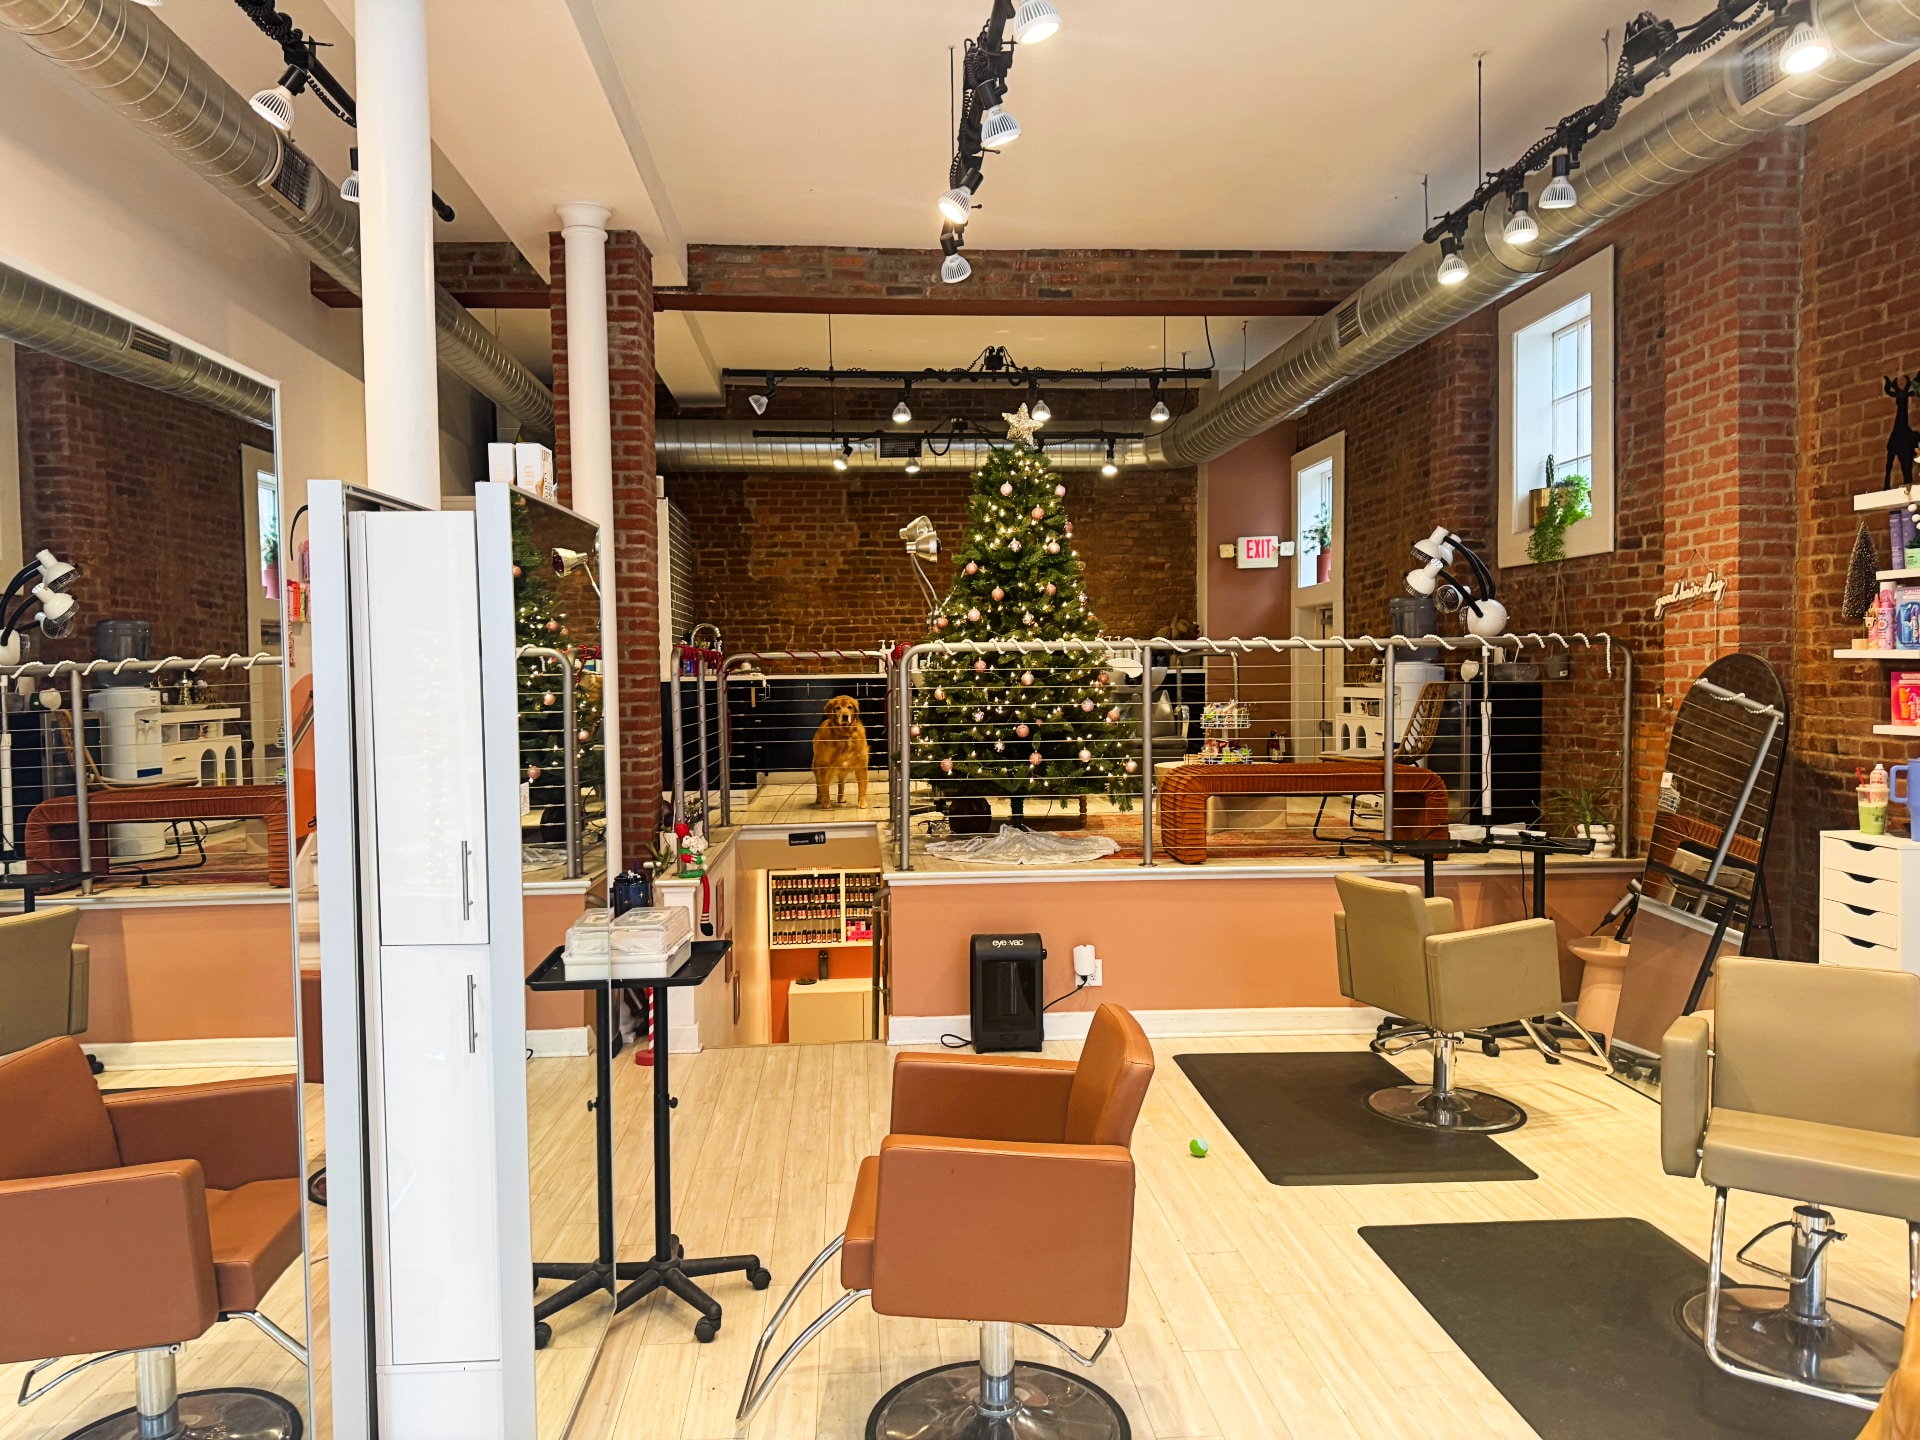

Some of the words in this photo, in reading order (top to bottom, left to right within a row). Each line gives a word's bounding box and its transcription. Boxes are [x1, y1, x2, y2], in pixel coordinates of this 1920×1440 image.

[1246, 539, 1272, 559] EXIT
[1654, 582, 1680, 618] good
[1679, 580, 1703, 601] hair
[1702, 572, 1726, 603] day
[992, 939, 1007, 948] eye
